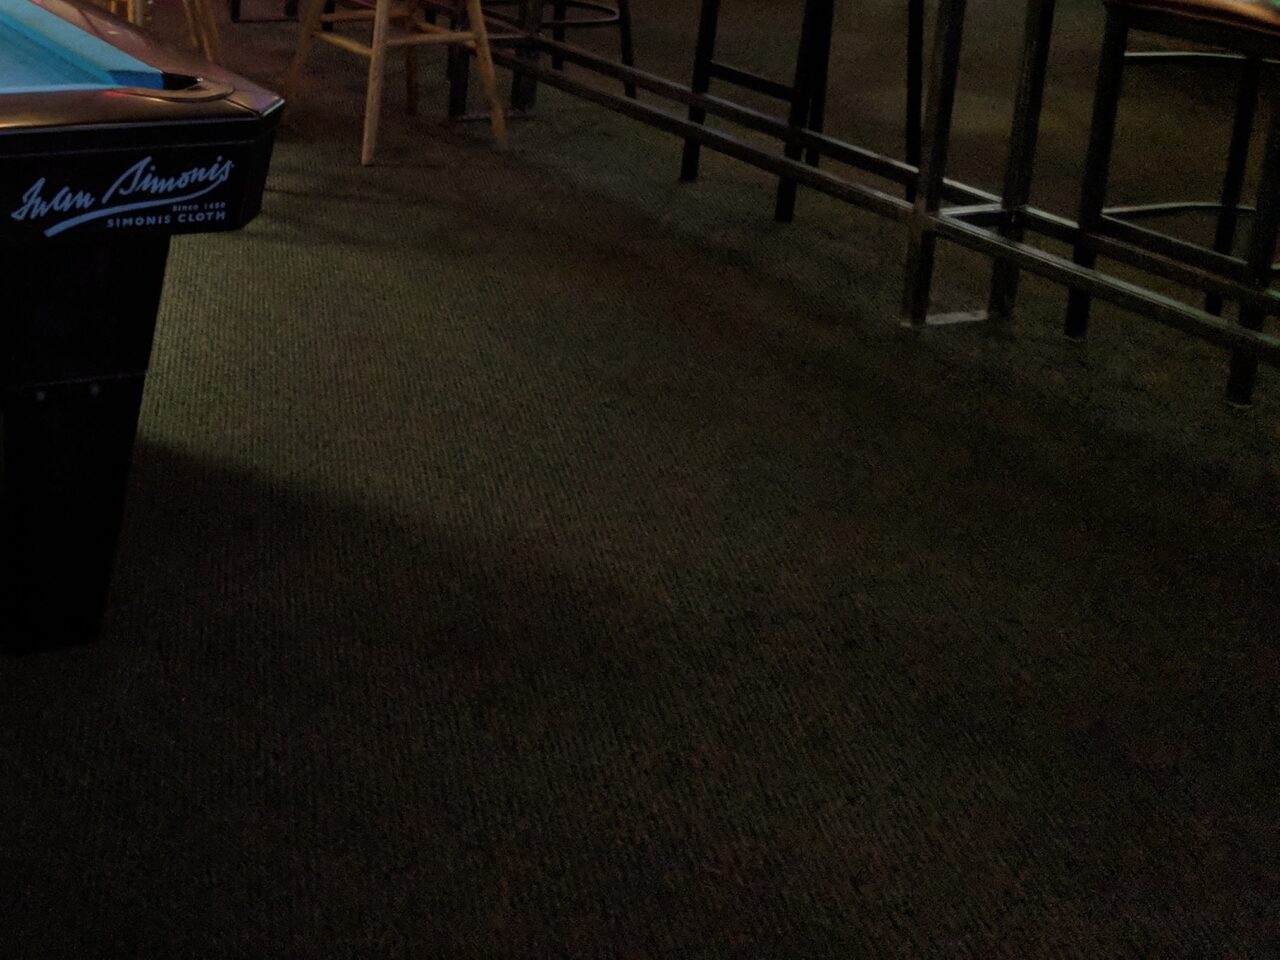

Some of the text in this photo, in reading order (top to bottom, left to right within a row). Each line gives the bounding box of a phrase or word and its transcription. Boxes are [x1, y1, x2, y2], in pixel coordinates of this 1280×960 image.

[101, 154, 236, 205] Simonis
[106, 210, 227, 230] SIMONIS CLOTH
